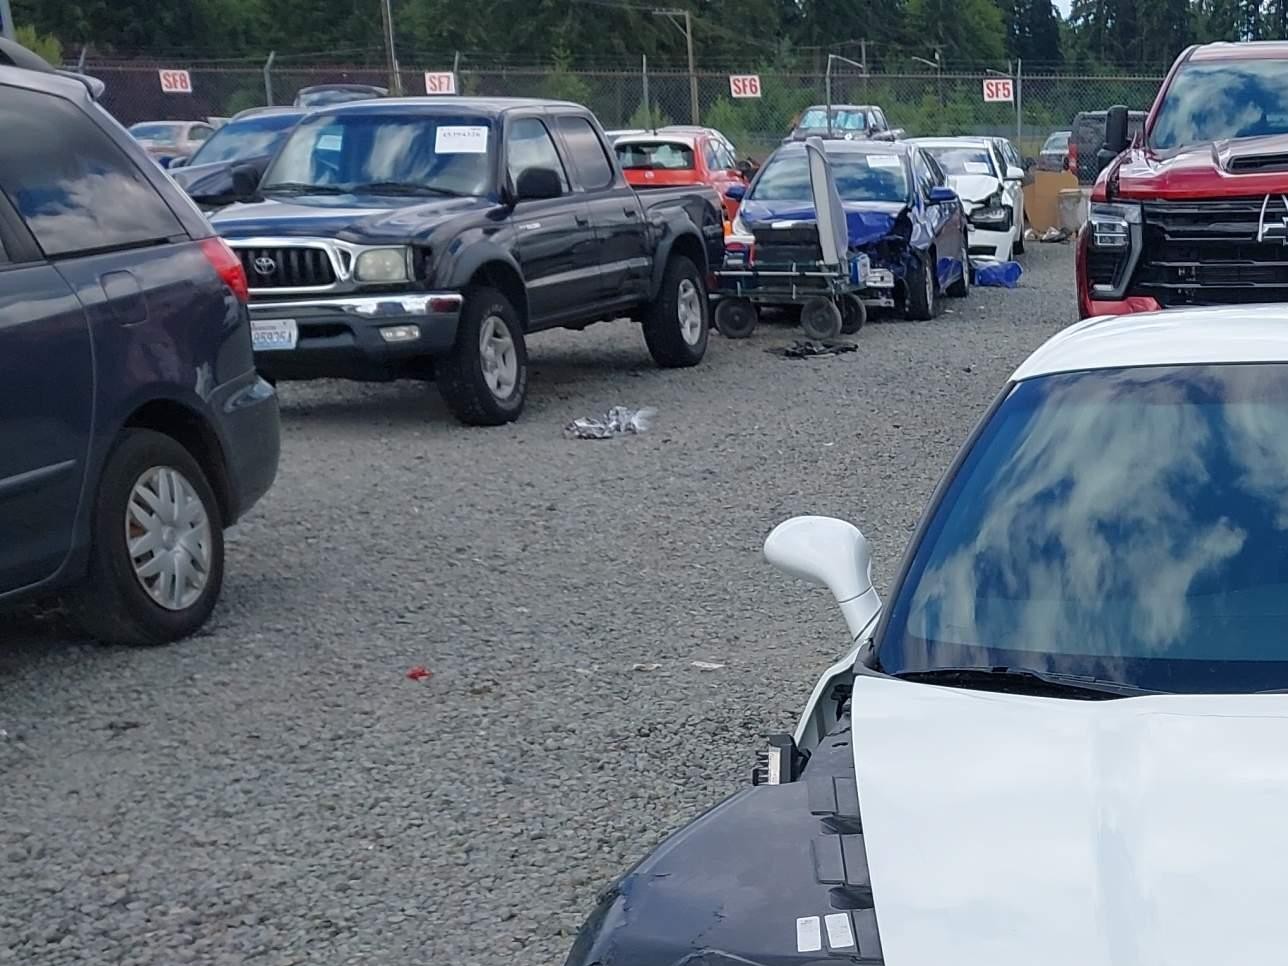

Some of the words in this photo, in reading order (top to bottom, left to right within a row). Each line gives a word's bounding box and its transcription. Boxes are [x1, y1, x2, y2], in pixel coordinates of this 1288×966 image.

[163, 72, 188, 89] SF8
[429, 75, 450, 91] SF7
[733, 78, 758, 95] SF6
[986, 81, 1012, 98] SF5
